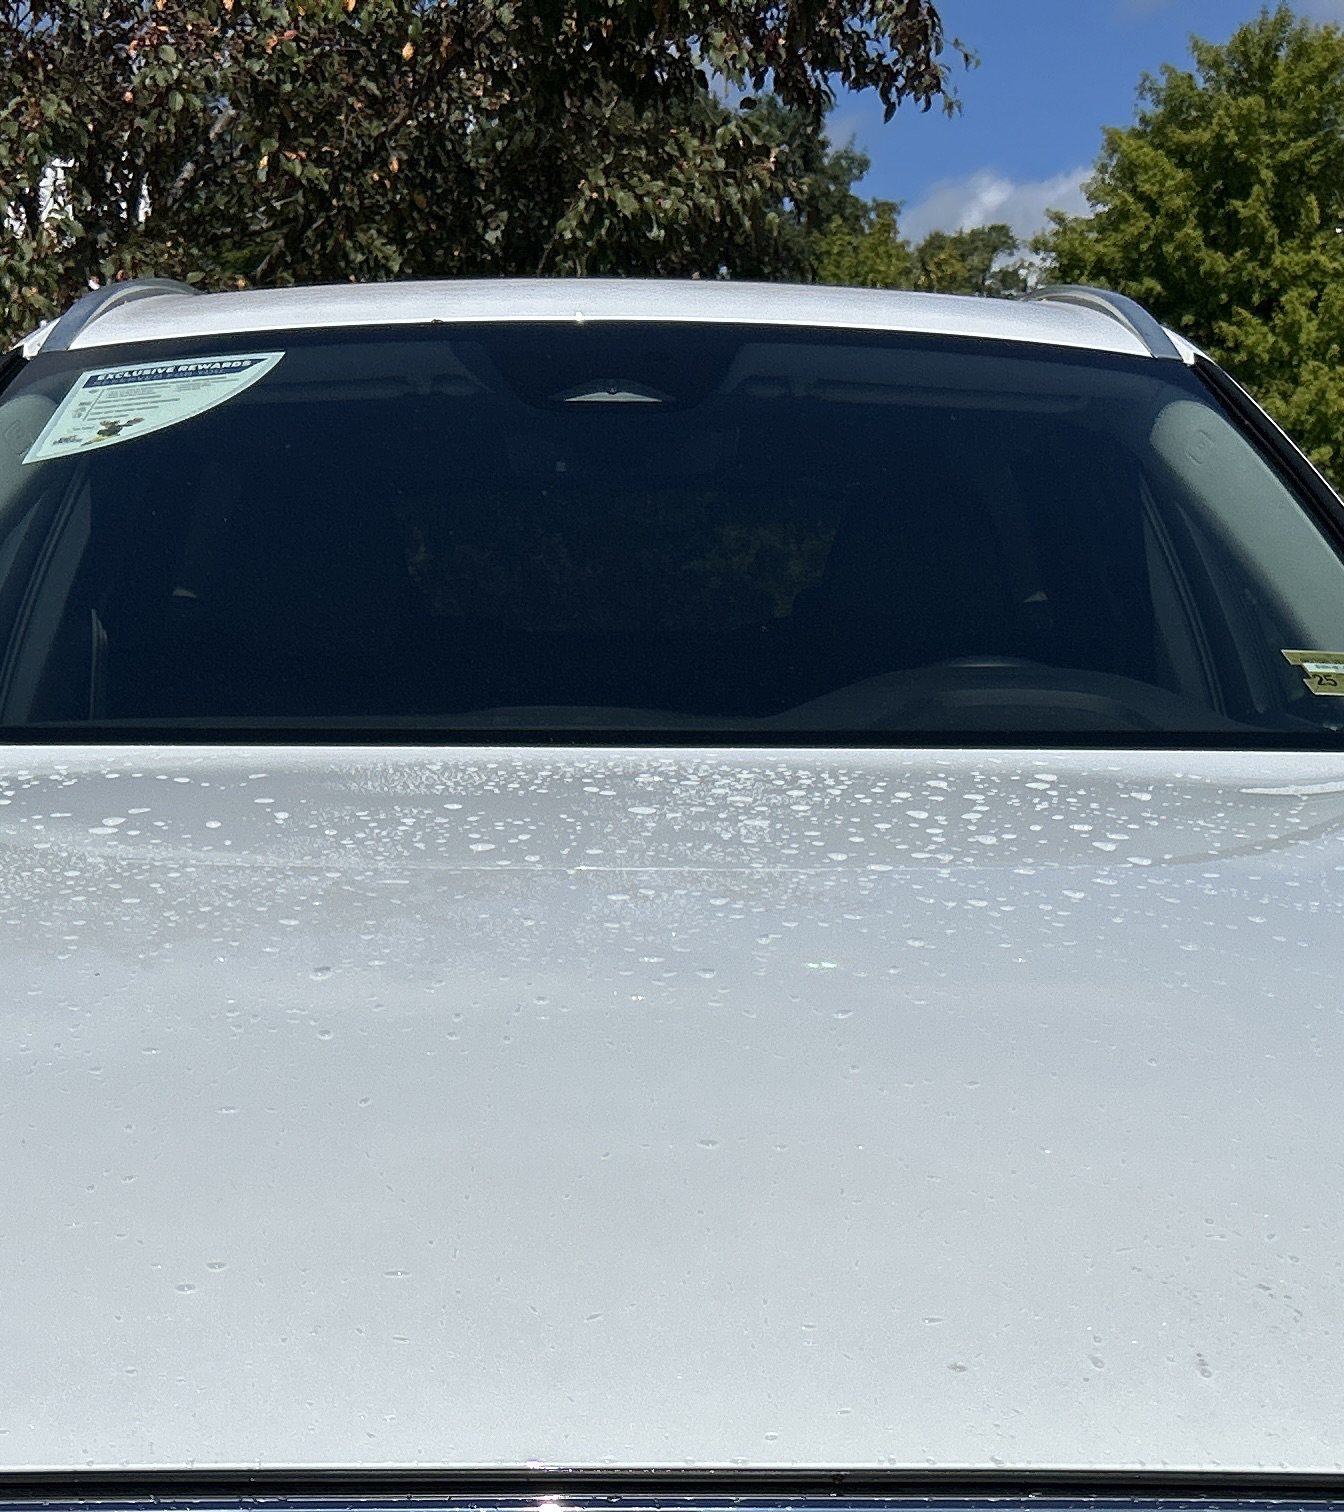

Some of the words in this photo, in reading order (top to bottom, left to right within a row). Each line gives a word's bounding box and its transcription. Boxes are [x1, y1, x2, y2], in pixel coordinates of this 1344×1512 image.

[97, 365, 175, 381] EXCLUSIVE
[177, 360, 253, 373] REWARDS
[1312, 674, 1338, 687] 25
